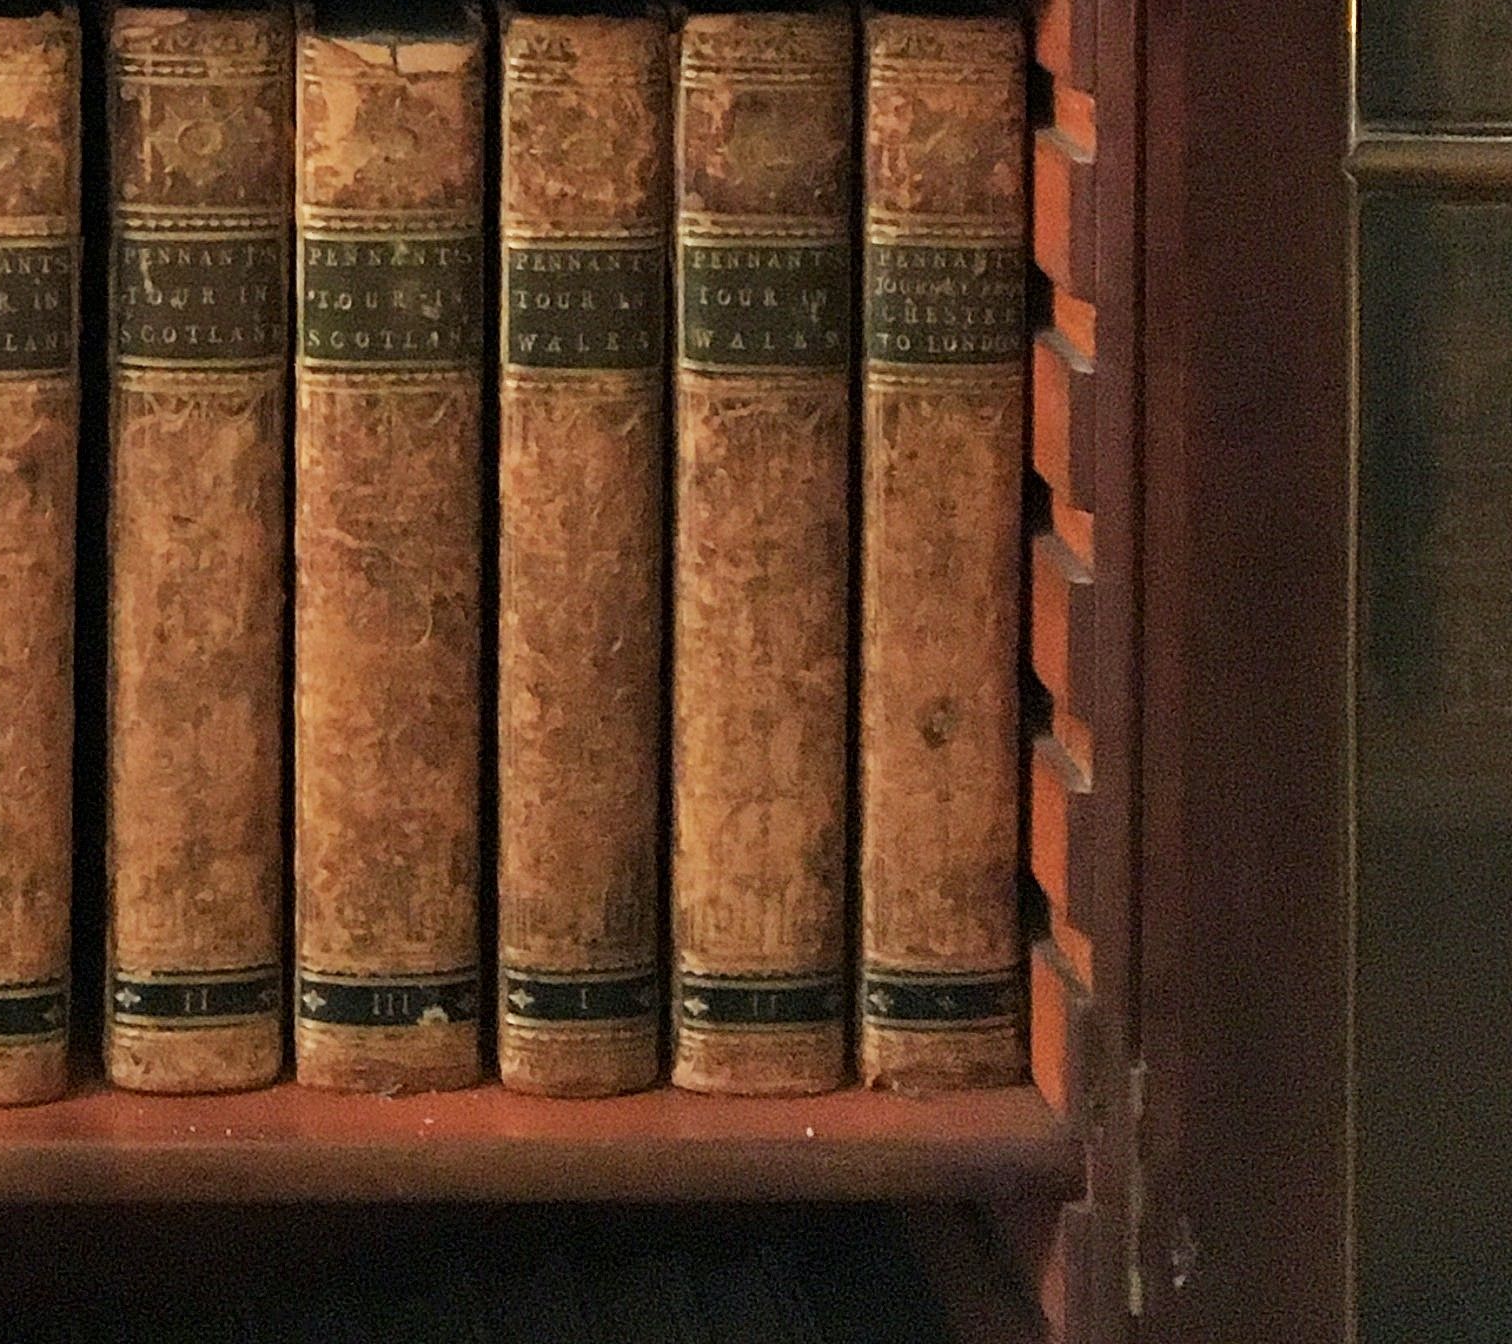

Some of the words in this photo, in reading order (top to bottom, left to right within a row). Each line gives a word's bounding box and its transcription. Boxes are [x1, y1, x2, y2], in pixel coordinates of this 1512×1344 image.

[33, 291, 59, 310] IN
[127, 286, 215, 310] TOUR
[240, 285, 268, 304] IN
[318, 290, 406, 310] TOUR
[512, 290, 595, 309] TOUR
[698, 285, 778, 307] TOUR
[307, 328, 475, 350] SCOTLAN
[517, 332, 649, 352] WALES
[692, 328, 838, 350] WALES
[876, 333, 911, 351] TO
